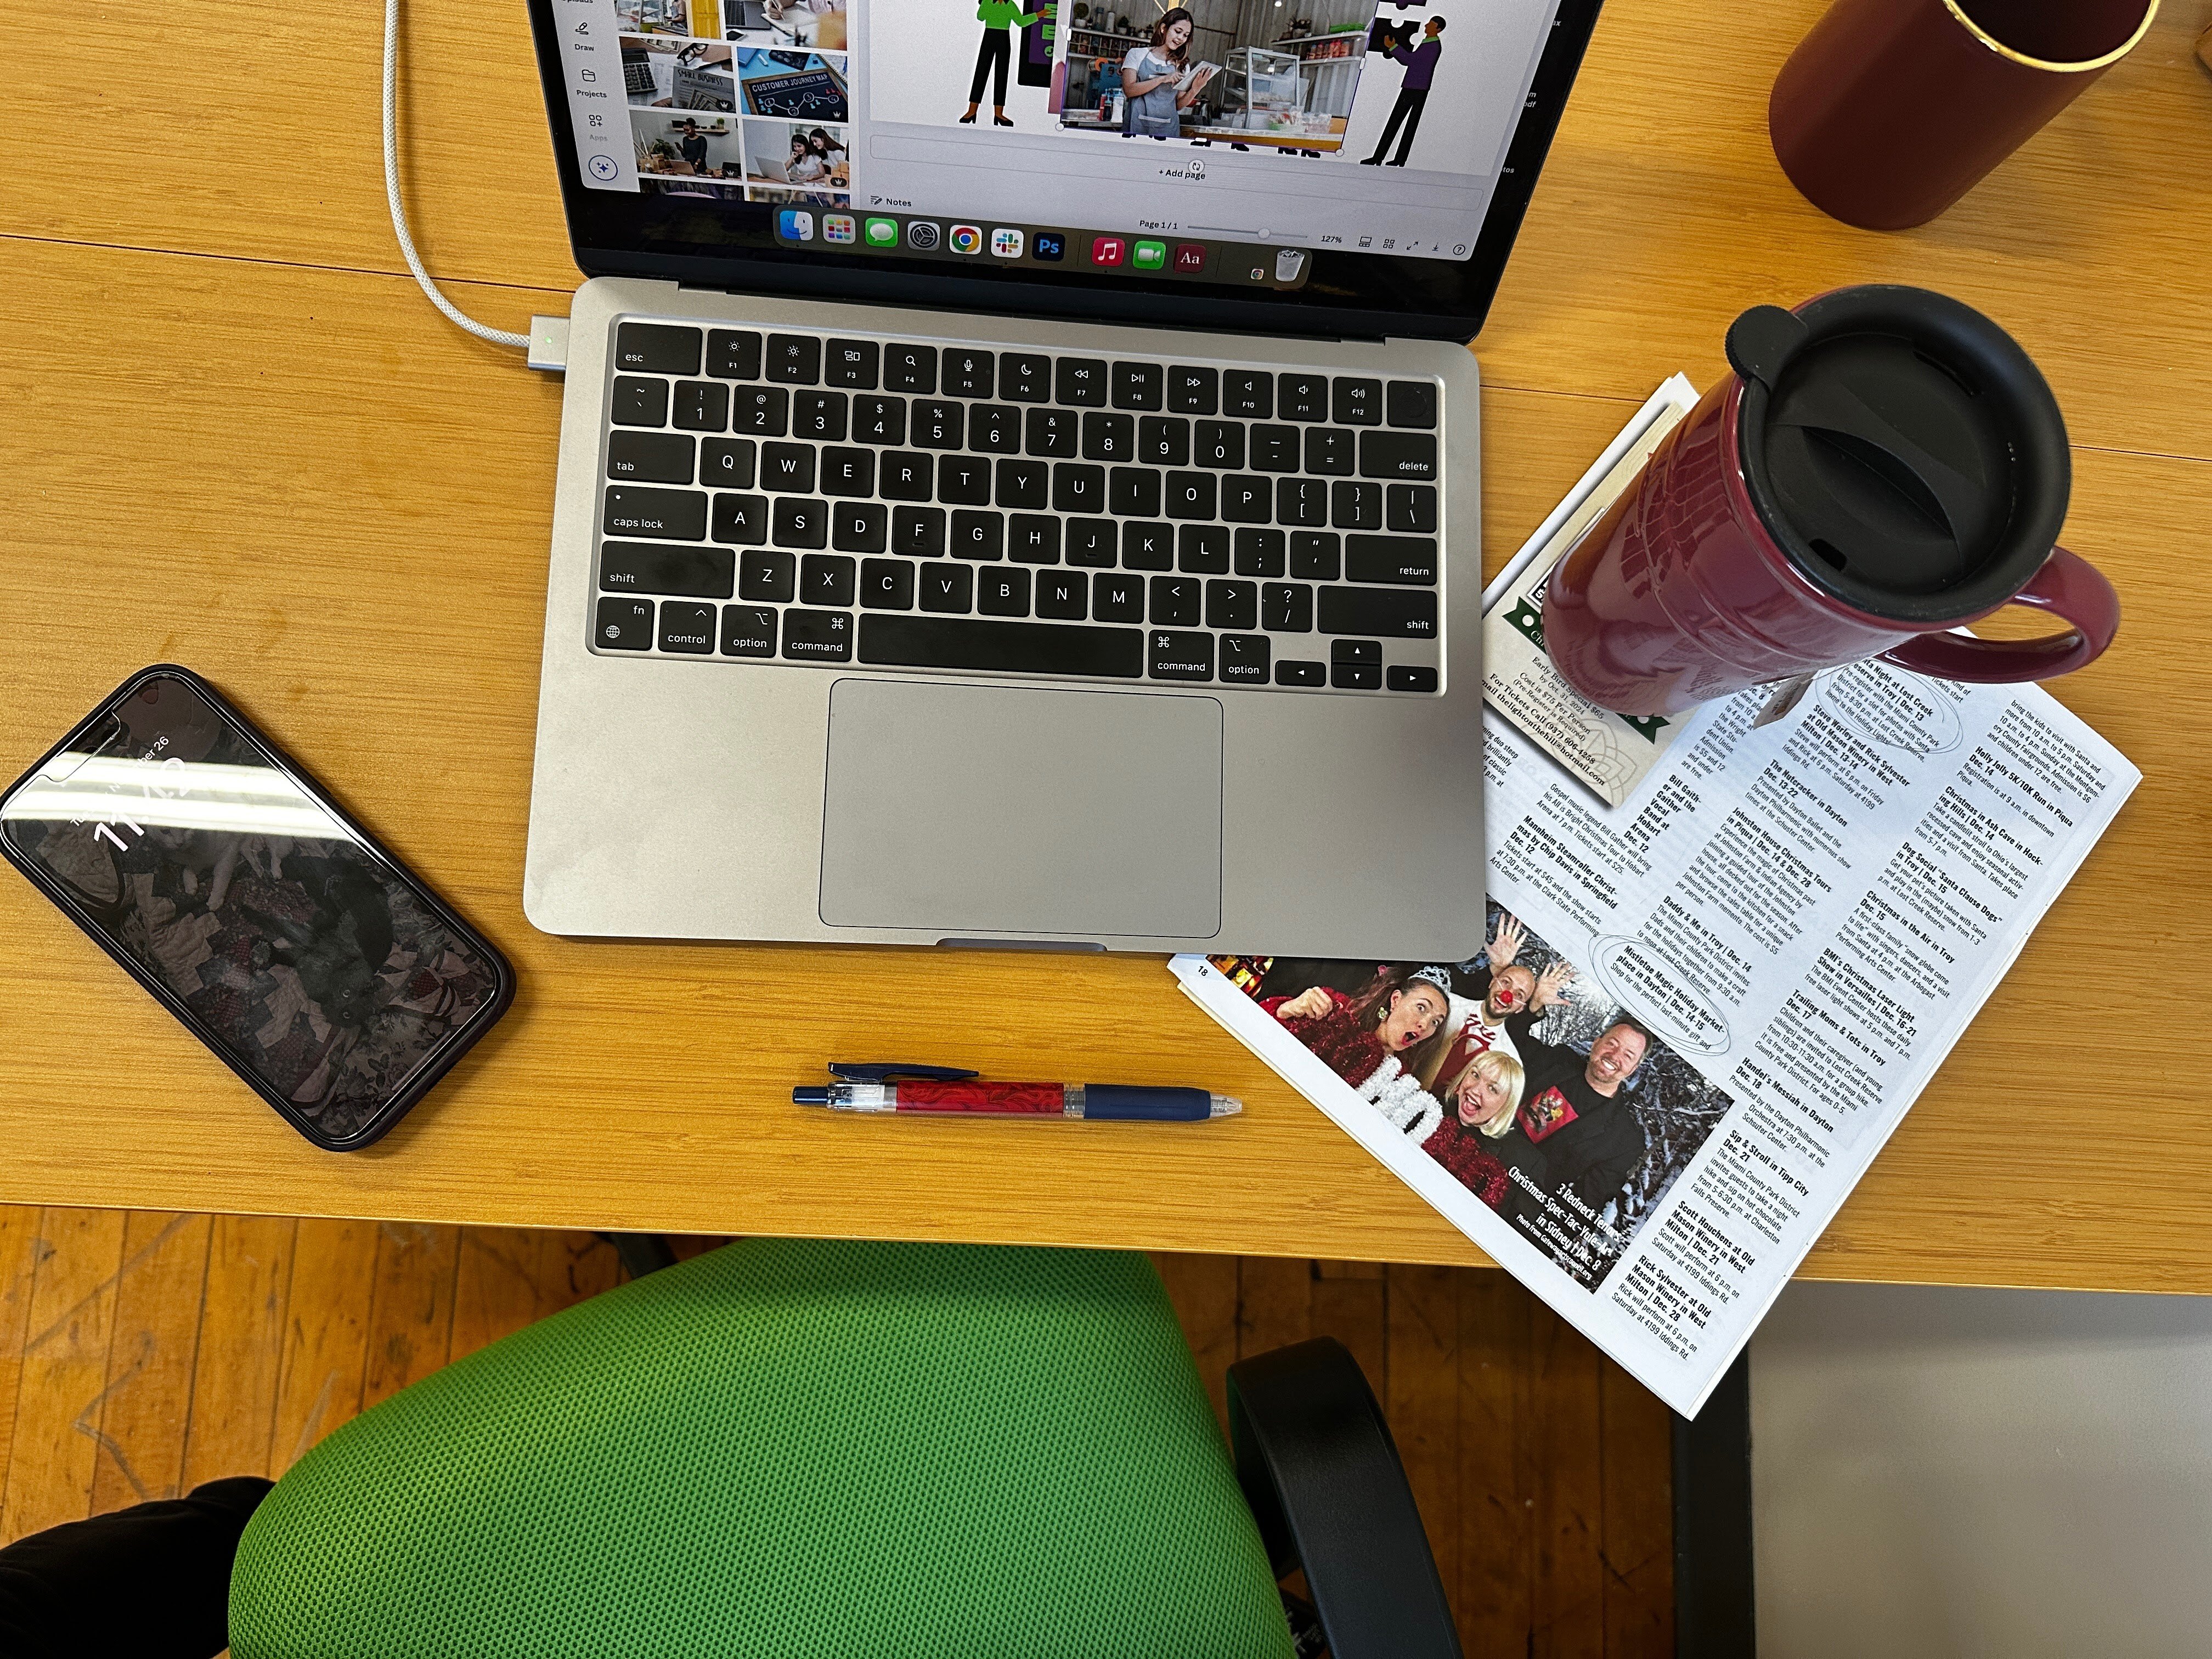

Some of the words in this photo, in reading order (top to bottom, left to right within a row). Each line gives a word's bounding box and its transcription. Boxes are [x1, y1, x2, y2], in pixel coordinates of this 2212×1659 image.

[678, 69, 696, 80] SMALL
[697, 72, 723, 86] BUSINESS
[752, 81, 789, 92] CUSTOMER
[790, 76, 816, 86] JOURNEY
[816, 73, 828, 82] MAP
[576, 89, 607, 99] Projects
[589, 134, 608, 143] Apps
[1165, 169, 1183, 178] Add
[1185, 171, 1206, 180] page
[886, 198, 912, 207] Notes
[1139, 220, 1159, 229] Page
[1039, 239, 1059, 253] Ps
[1321, 235, 1342, 244] 127%
[1180, 252, 1200, 264] Aa
[625, 354, 644, 362] esc
[697, 408, 702, 420] 1
[756, 412, 765, 425] 2
[815, 416, 825, 430] 3
[874, 421, 884, 434] 4
[933, 426, 942, 438] 5
[990, 430, 999, 443] 6
[1048, 434, 1056, 447] 7
[1104, 438, 1113, 450] 8
[1160, 442, 1169, 454] 9
[1215, 445, 1224, 458] 0
[617, 462, 634, 471] tab
[723, 455, 733, 470] Q
[781, 459, 797, 473] W
[1399, 461, 1429, 471] delete
[843, 464, 853, 477] E
[902, 468, 911, 482] R
[960, 472, 970, 486] T
[1018, 476, 1027, 489] Y
[1074, 480, 1084, 493] U
[1134, 484, 1137, 497] I
[1186, 488, 1197, 501] O
[1243, 492, 1252, 504] P
[614, 518, 639, 528] caps
[641, 518, 663, 529] lock
[735, 511, 746, 524] A
[795, 515, 805, 529] S
[855, 520, 866, 533] D
[915, 523, 924, 537] F
[973, 527, 983, 540] G
[1030, 531, 1040, 544] H
[1087, 535, 1095, 548] J
[1144, 538, 1153, 551] K
[1201, 541, 1209, 555] L
[762, 569, 772, 582] Z
[1400, 567, 1429, 575] return
[610, 573, 635, 583] shift
[823, 572, 834, 586] X
[882, 577, 893, 590] C
[941, 580, 952, 593] V
[1000, 584, 1009, 596] B
[1057, 587, 1067, 600] N
[1113, 590, 1125, 603] M
[633, 605, 645, 615] fn
[1407, 620, 1429, 629] shift
[668, 635, 706, 644] control
[733, 637, 767, 648] option
[792, 642, 843, 652] command
[1158, 663, 1205, 672] command
[1228, 665, 1259, 675] option
[1532, 656, 1551, 675] Early
[1550, 672, 1569, 689] Bird
[1565, 686, 1593, 709] Special
[1590, 706, 1605, 719] $65
[1873, 665, 1892, 684] Night
[1891, 681, 1900, 690] at
[1899, 686, 1914, 701] Lost
[1913, 698, 1933, 717] Creek
[1539, 674, 1548, 684] by
[1548, 682, 1559, 693] Oct.
[1569, 701, 1585, 715] 2024
[1520, 672, 1536, 688] Cost
[1542, 691, 1556, 704] $75
[1555, 702, 1568, 715] Per
[1567, 713, 1590, 735] Person
[1513, 679, 1551, 712] (Pre-Register
[1556, 715, 1585, 742] Required)
[1489, 673, 1504, 687] For
[1504, 685, 1530, 710] Tickets
[1531, 709, 1547, 724] Call
[1545, 721, 1564, 739] (937)
[1564, 737, 1596, 764] 606-4258
[154, 736, 170, 751] 26
[1497, 693, 1605, 786] thelightonthehill@hotmail.com
[1813, 704, 1831, 723] Steve
[1831, 719, 1853, 741] Worley
[1852, 738, 1867, 751] and
[1865, 747, 1881, 764] Rick
[1880, 760, 1910, 787] Sylvester
[1975, 746, 1994, 764] Holly
[1991, 760, 2009, 776] Jolly
[2008, 772, 2035, 795] 5K/10K
[2032, 791, 2047, 806] Run
[2046, 802, 2055, 812] in
[2053, 808, 2073, 827] Piqua
[1901, 842, 1917, 857] Dog
[1915, 853, 1938, 873] Social
[1938, 868, 1959, 891] “Santa
[1959, 888, 1981, 909] Clause
[1980, 905, 2002, 922] Dogs”
[1198, 966, 1208, 977] 18
[1623, 945, 1655, 974] Mistletoe
[1654, 970, 1674, 991] Magic
[1673, 988, 1700, 1012] Holiday
[1698, 1008, 1725, 1032] Market-
[1741, 1057, 1772, 1084] Handel’s
[1771, 1080, 1800, 1107] Messiah
[1799, 1104, 1809, 1113] in
[1808, 1109, 1834, 1133] Dayton
[1508, 1166, 1548, 1204] Christmas
[1556, 1183, 1567, 1195] 3
[1562, 1188, 1596, 1221] Redneck
[1593, 1213, 1623, 1242] Tenors
[1516, 1214, 1530, 1228] Photo
[1528, 1223, 1542, 1238] from
[1536, 1212, 1547, 1227] in
[1544, 1221, 1573, 1250] Sidney
[1576, 1243, 1593, 1266] Dec.
[1592, 1259, 1601, 1271] 8
[1651, 1237, 1678, 1261] Saturday
[1677, 1259, 1685, 1267] at
[1684, 1264, 1700, 1279] 4199
[1699, 1276, 1720, 1296] Iddings
[1719, 1292, 1729, 1304] Rd.
